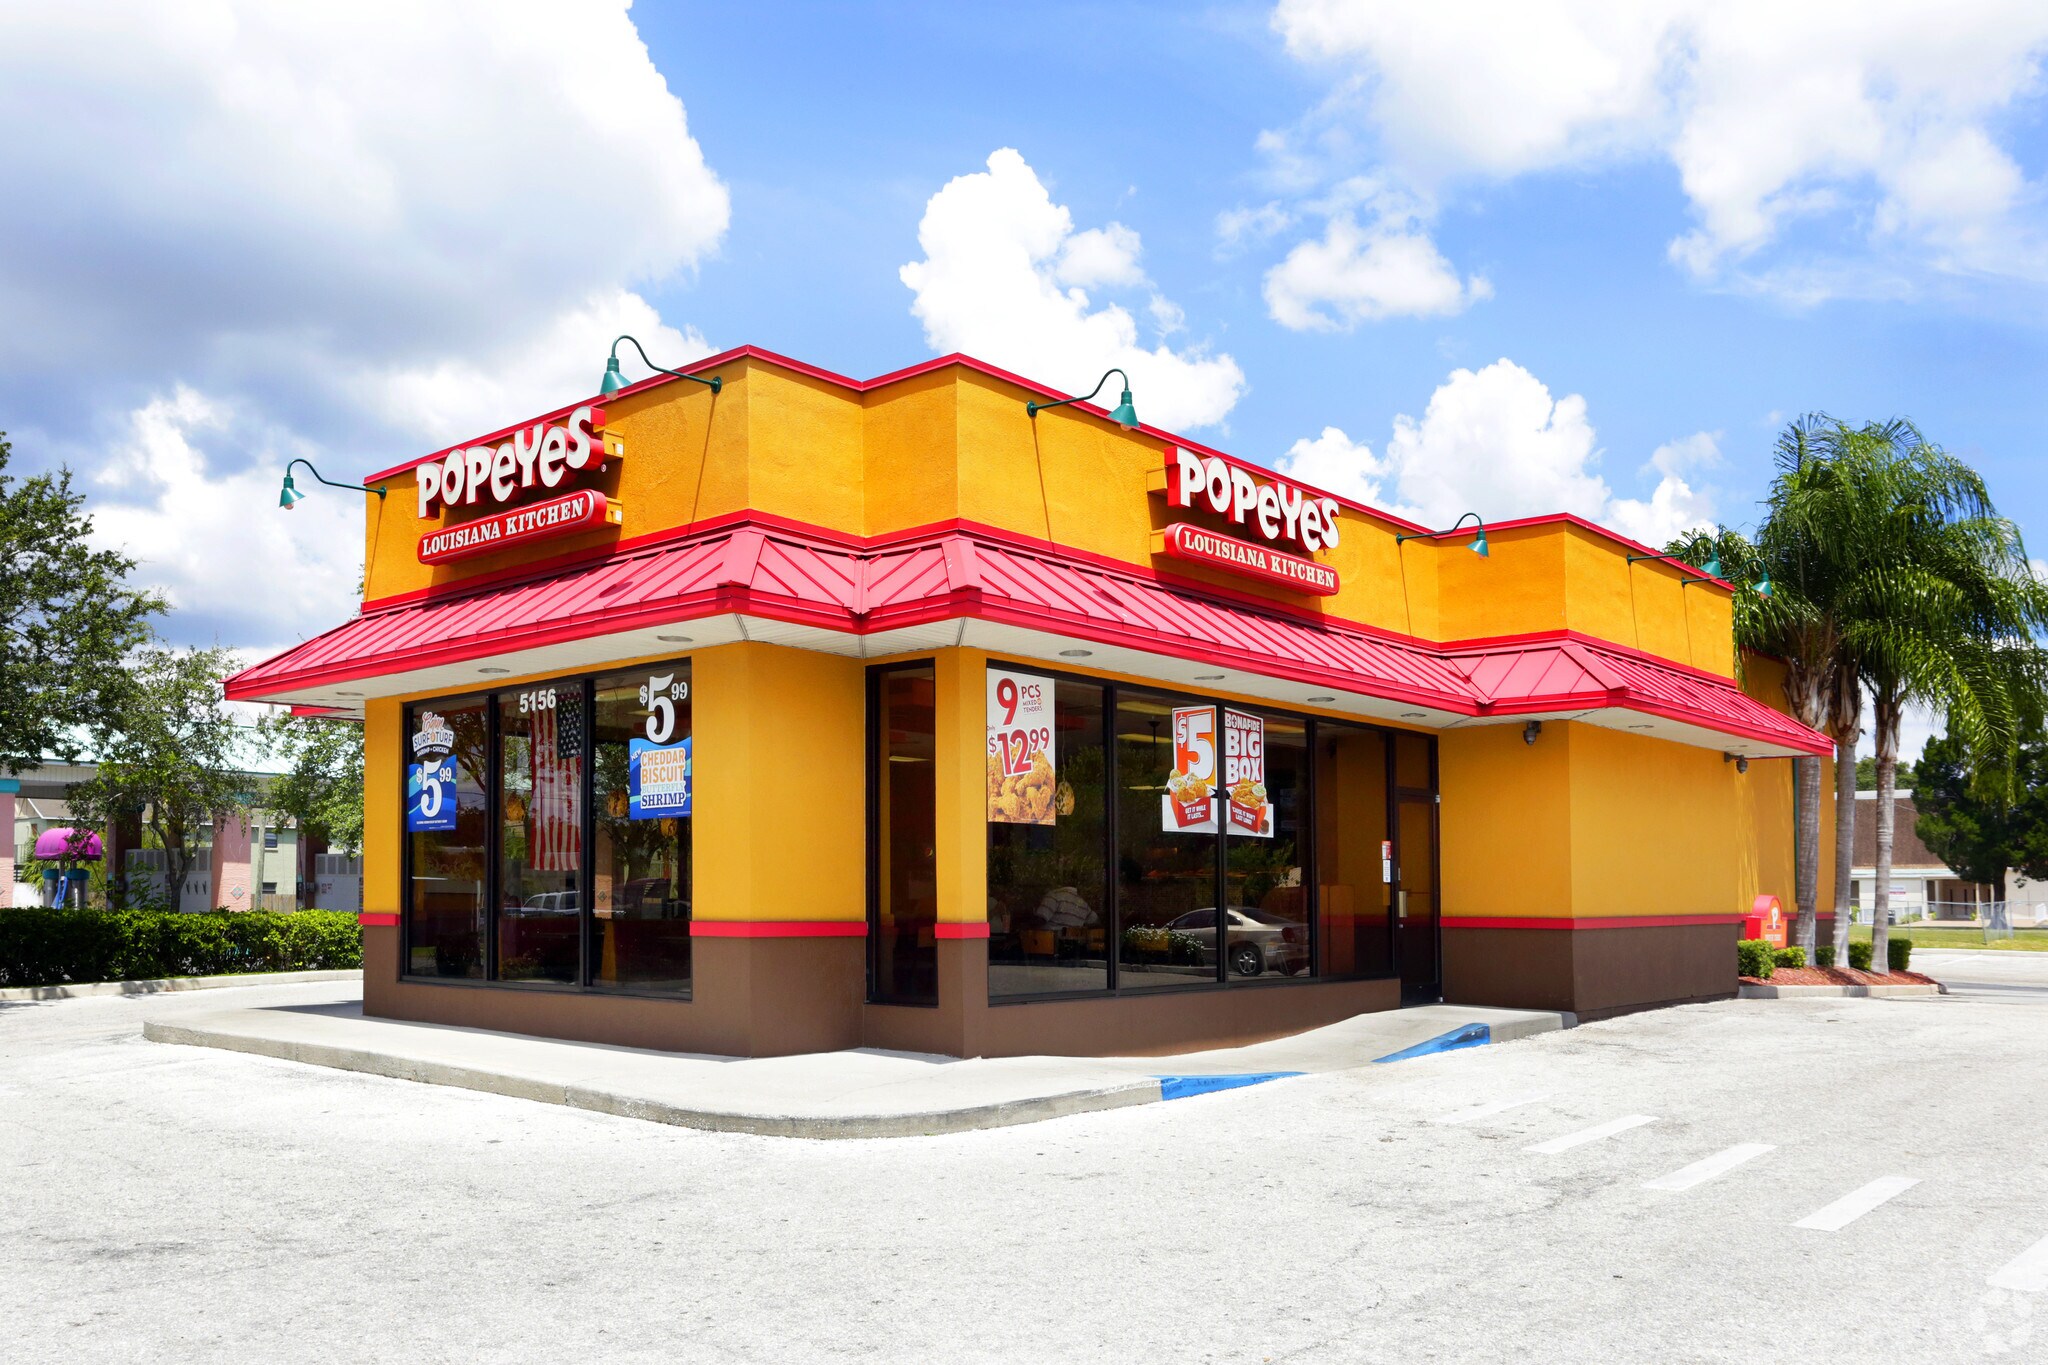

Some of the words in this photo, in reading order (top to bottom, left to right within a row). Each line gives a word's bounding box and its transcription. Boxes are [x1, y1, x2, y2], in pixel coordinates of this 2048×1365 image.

[422, 521, 502, 557] LOUISIANA
[505, 497, 586, 536] KITCHEN
[1184, 530, 1267, 570] LOUISIANA
[1270, 555, 1336, 589] KITCHEN
[519, 688, 557, 713] 5156
[997, 678, 1018, 726] 9
[1021, 684, 1041, 699] PCS
[1225, 712, 1261, 732] BONAFIDE
[413, 733, 430, 748] SURF
[435, 731, 453, 743] TURF
[1225, 728, 1261, 758] BIG
[631, 747, 642, 761] NEW
[641, 749, 685, 767] CHEDDAR
[641, 765, 685, 784] BISCUIT
[1226, 756, 1261, 784] BOX
[641, 782, 685, 794] BUTTERFLY
[641, 792, 685, 807] SHRIMP
